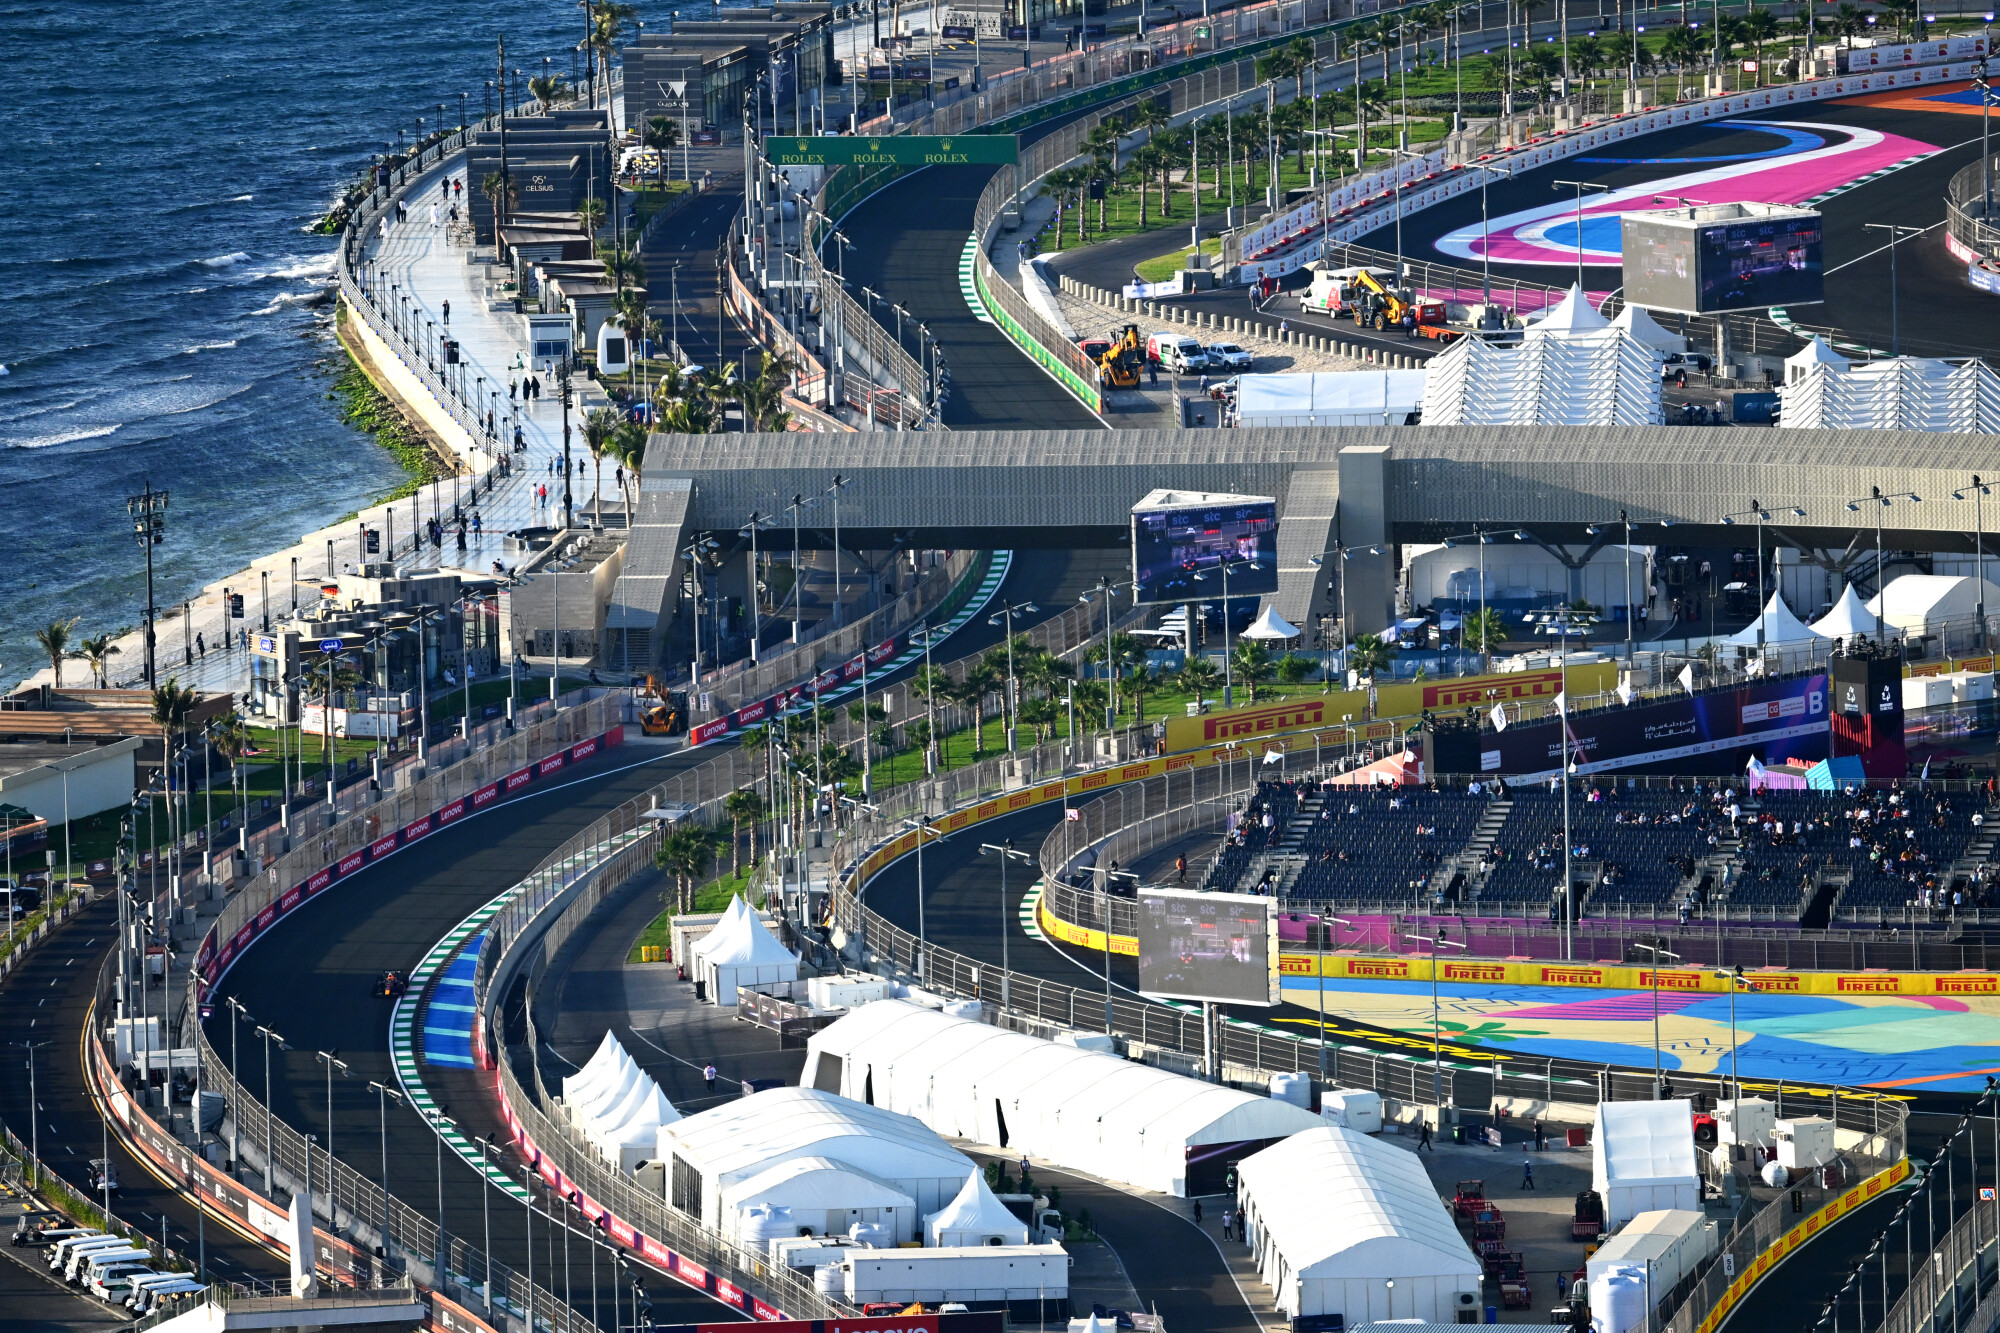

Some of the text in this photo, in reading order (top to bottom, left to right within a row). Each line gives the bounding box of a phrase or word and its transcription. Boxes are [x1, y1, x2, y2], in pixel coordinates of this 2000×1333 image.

[781, 154, 825, 164] ROLEX
[853, 154, 896, 163] ROLEX
[925, 153, 968, 163] ROLEX
[525, 184, 554, 192] CELSIUS
[1732, 228, 1746, 239] stc
[1759, 225, 1774, 235] stc
[1172, 514, 1189, 526] stc
[1204, 511, 1221, 523] stc
[1423, 672, 1564, 708] PIRELLI
[1769, 705, 1778, 714] CG
[1808, 691, 1823, 714] B
[740, 705, 763, 722] Lenovo
[1203, 701, 1325, 740] PIRELLI
[703, 720, 726, 738] Lenovo
[1367, 722, 1401, 738] PIRELLI
[1262, 738, 1293, 752] PIRELLI
[1313, 730, 1346, 745] PIRELLI
[573, 742, 595, 759] Lenovo
[541, 757, 562, 773] Lenovo
[1166, 754, 1195, 770] PIRELLI
[508, 772, 529, 788] Lenovo
[1122, 764, 1150, 780] PIRELLI
[1082, 773, 1108, 789] PIRELLI
[474, 788, 496, 804] Lenovo
[1009, 792, 1030, 808] PIRELLI
[440, 804, 462, 822] Lenovo
[978, 802, 998, 818] PIRELLI
[950, 813, 968, 829] PIRELLI
[407, 821, 429, 838] Lenovo
[373, 838, 395, 856] Lenovo
[340, 856, 361, 873] Lenovo
[309, 874, 329, 890] Lenovo
[282, 892, 299, 909] Lenovo
[1171, 903, 1187, 914] stc
[1200, 904, 1216, 916] stc
[258, 909, 273, 927] Lenovo
[238, 928, 250, 946] Lenovo
[1348, 960, 1408, 976] PIRELLI
[1445, 964, 1505, 980] PIRELLI
[1542, 968, 1602, 984] PIRELLI
[1640, 972, 1701, 988] PIRELLI
[1838, 976, 1898, 992] PIRELLI
[1936, 977, 1998, 992] PIRELLI
[1890, 1165, 1902, 1184] PIRELLI
[1866, 1178, 1880, 1196] PIRELLI
[1846, 1190, 1859, 1208] PIRELLI
[1826, 1202, 1838, 1222] PIRELLI
[612, 1220, 632, 1241] Lenovo
[1807, 1216, 1818, 1234] PIRELLI
[1789, 1229, 1800, 1248] PIRELLI
[644, 1240, 667, 1262] Lenovo
[680, 1262, 704, 1282] Lenovo
[1726, 1258, 1732, 1271] 50
[718, 1282, 742, 1303] Lenovo
